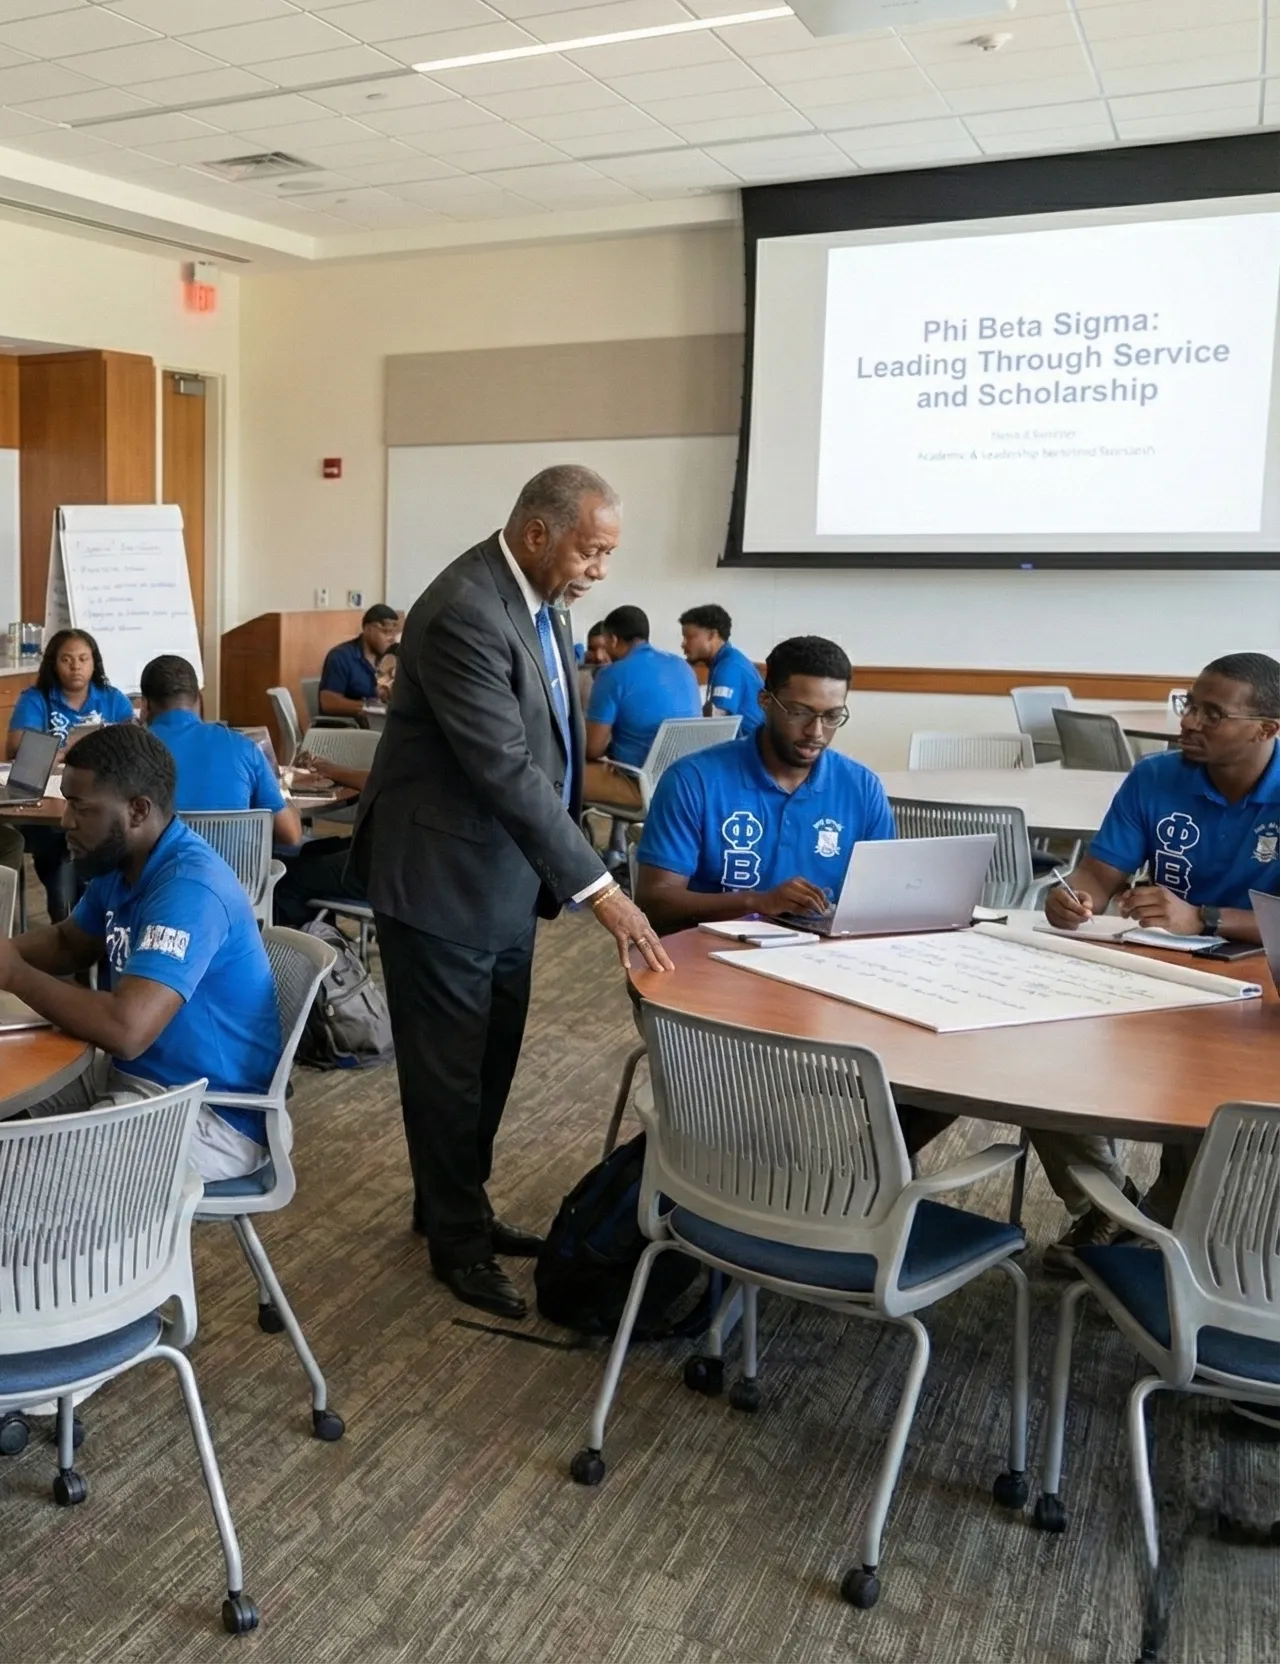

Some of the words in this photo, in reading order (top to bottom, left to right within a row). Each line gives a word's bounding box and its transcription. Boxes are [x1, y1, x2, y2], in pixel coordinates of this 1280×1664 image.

[923, 318, 968, 343] Phi
[978, 316, 1042, 340] Beta
[1053, 311, 1159, 340] Sigma:
[857, 353, 968, 380] Leading
[977, 345, 1102, 375] Through
[1113, 340, 1230, 367] Service
[917, 384, 968, 408] and
[977, 377, 1159, 407] Scholarship
[721, 811, 763, 892] ΦΒ
